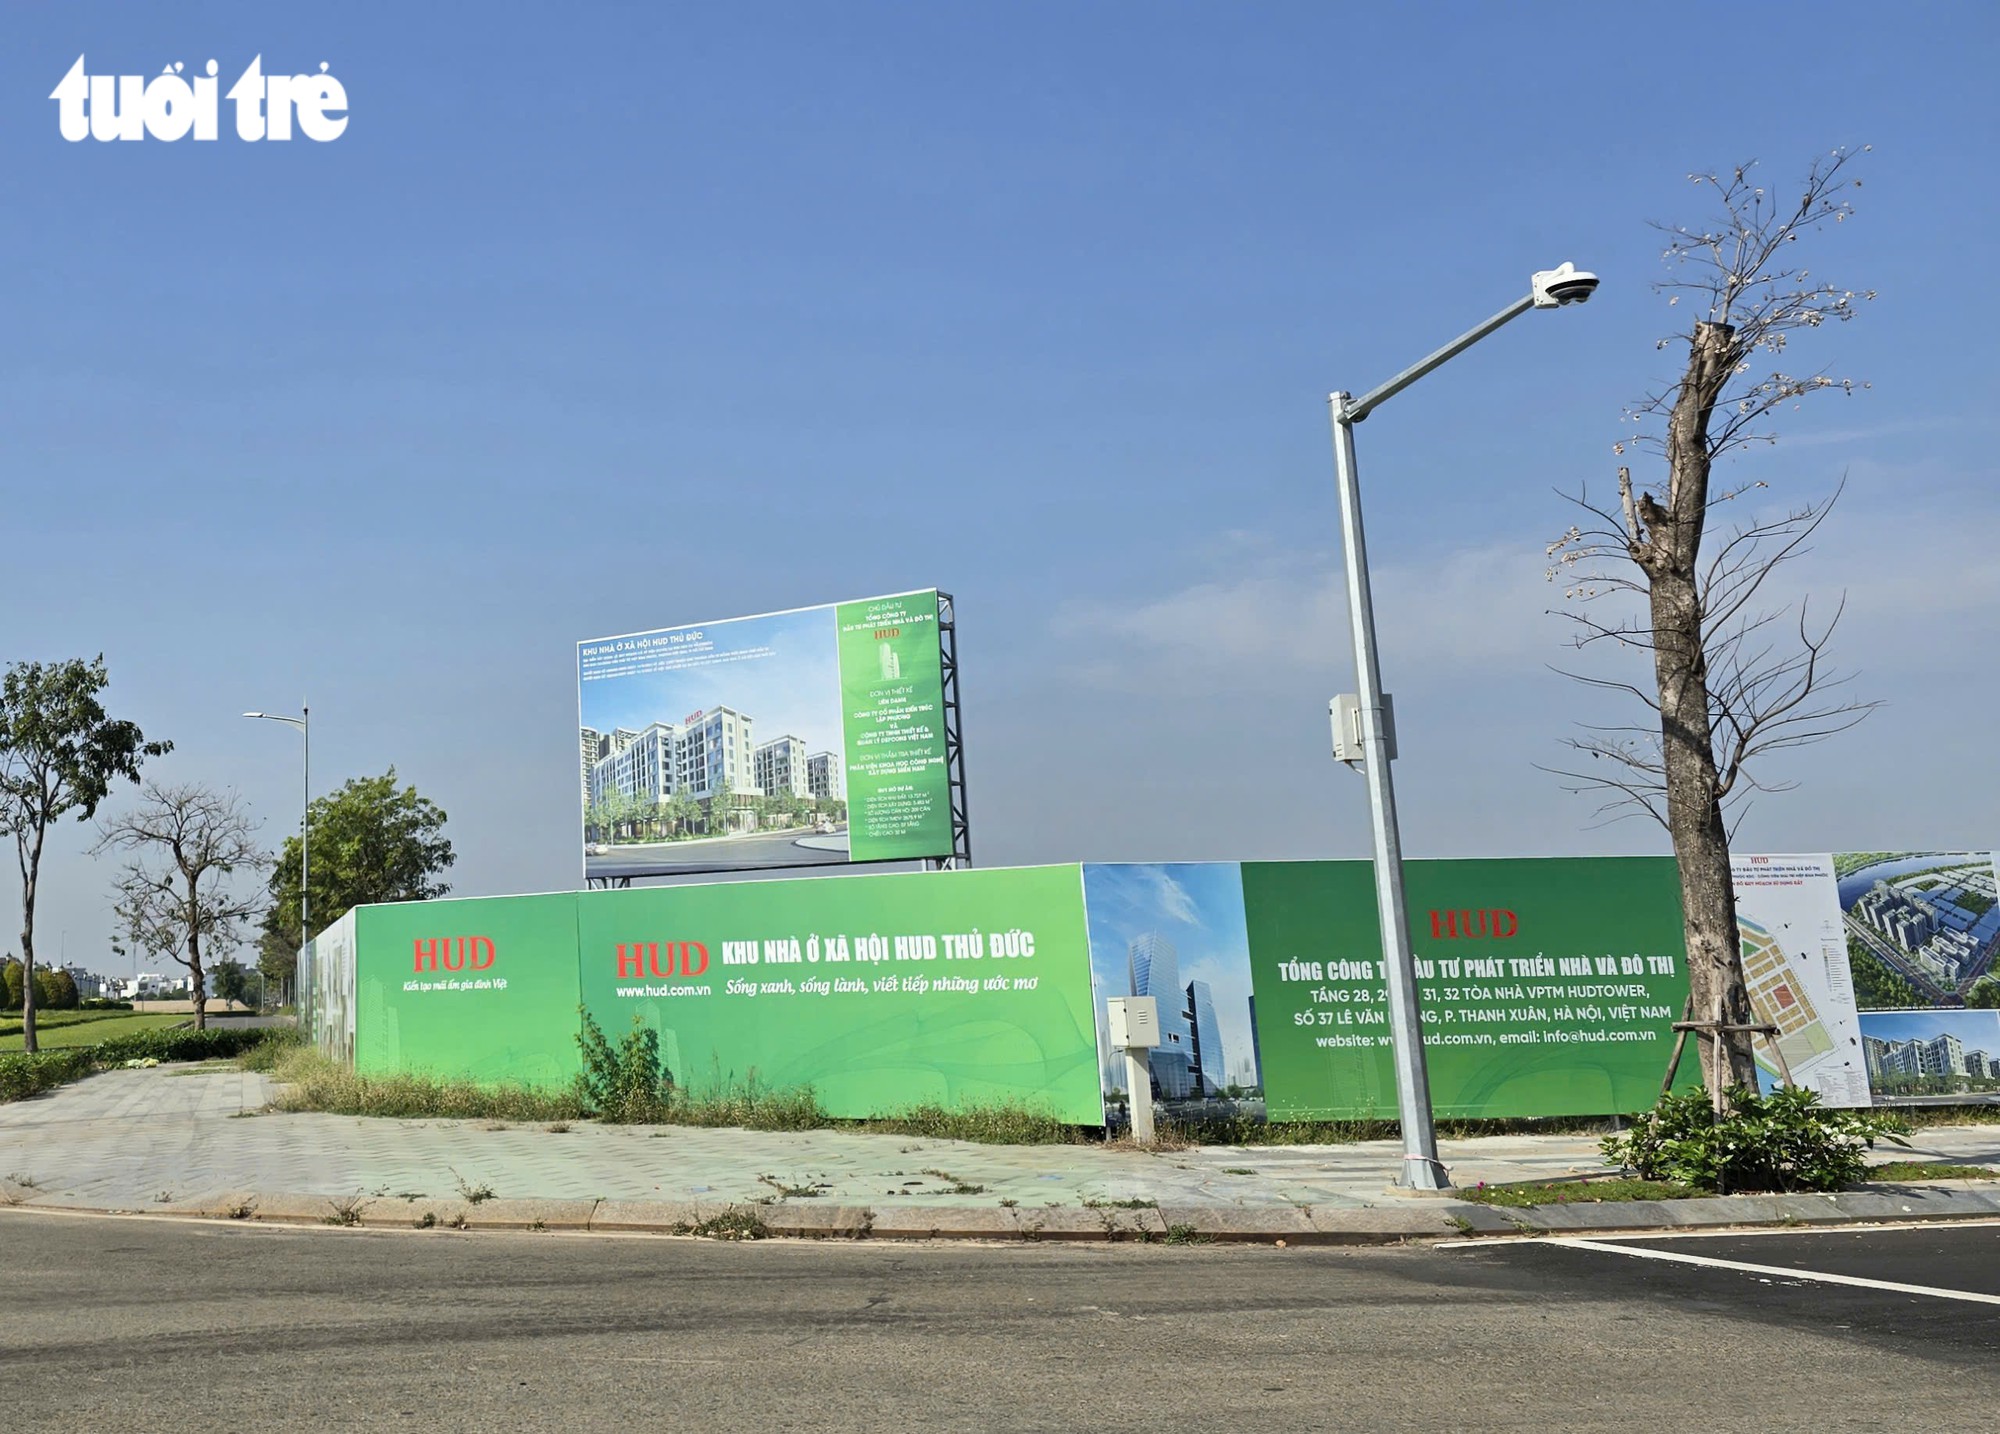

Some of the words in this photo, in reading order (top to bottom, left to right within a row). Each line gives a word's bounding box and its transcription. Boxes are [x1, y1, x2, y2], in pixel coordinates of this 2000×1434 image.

[583, 647, 598, 657] KHU
[599, 645, 615, 654] NHÀ
[625, 641, 635, 650] XÃ
[637, 640, 651, 649] HỘI
[653, 638, 668, 647] HUD
[670, 634, 684, 643] THỦ
[686, 632, 703, 641] ĐỨC
[875, 628, 900, 640] HUD
[685, 710, 702, 725] HUD
[1751, 856, 1769, 864] HUD
[1428, 908, 1518, 939] HUD
[414, 936, 496, 973] HUD
[722, 940, 758, 965] KHU
[764, 936, 801, 963] NHÀ
[807, 933, 821, 963] Ở
[824, 934, 850, 962] XÃ
[855, 933, 889, 966] HỘI
[895, 935, 937, 961] HUD
[941, 928, 983, 960] THỦ
[989, 928, 1035, 958] ĐỨC
[615, 941, 710, 979] HUD
[1278, 956, 1323, 981] TỔNG
[1327, 958, 1374, 980] CÔNG
[1438, 957, 1460, 979] TƯ
[1464, 956, 1504, 978] PHÁT
[1509, 952, 1555, 977] TRIỂN
[1559, 954, 1593, 976] NHÀ
[1595, 954, 1618, 976] VÀ
[1621, 954, 1644, 976] ĐÔ
[1647, 956, 1676, 978] THỊ
[403, 980, 419, 992] Kiến
[420, 982, 432, 992] tạo
[460, 980, 473, 992] gia
[492, 978, 508, 990] Việt
[616, 985, 711, 997] www.hud.com.vn
[726, 977, 758, 997] Sống
[760, 979, 796, 996] xanh,
[799, 976, 830, 997] sống
[834, 977, 870, 995] lành,
[873, 975, 899, 993] viết
[902, 974, 929, 995] tiếp
[933, 976, 979, 994] những
[983, 975, 1010, 991] ước
[1014, 977, 1039, 991] mơ
[1353, 989, 1374, 1004] 28,
[1423, 988, 1441, 1002] 31,
[1444, 988, 1460, 1000] 32
[1462, 984, 1492, 1000] TÒA
[1495, 984, 1525, 1000] NHÀ
[1527, 985, 1565, 1000] VPTM
[1568, 985, 1650, 999] HUDTOWER,
[1294, 1008, 1315, 1026] SỐ
[1318, 1012, 1334, 1025] 37
[1337, 1009, 1353, 1025] LÊ
[1355, 1008, 1385, 1024] VĂN
[1445, 1010, 1456, 1022] P.
[1459, 1008, 1506, 1023] THANH
[1509, 1005, 1551, 1022] XUÂN,
[1554, 1005, 1575, 1021] HÀ
[1576, 1004, 1606, 1023] NỘI,
[1608, 1004, 1637, 1022] VIỆT
[1641, 1006, 1672, 1019] NAM
[1316, 1034, 1375, 1047] website:
[1500, 1030, 1541, 1044] email:
[1543, 1030, 1657, 1044] info@hud.com.vn
